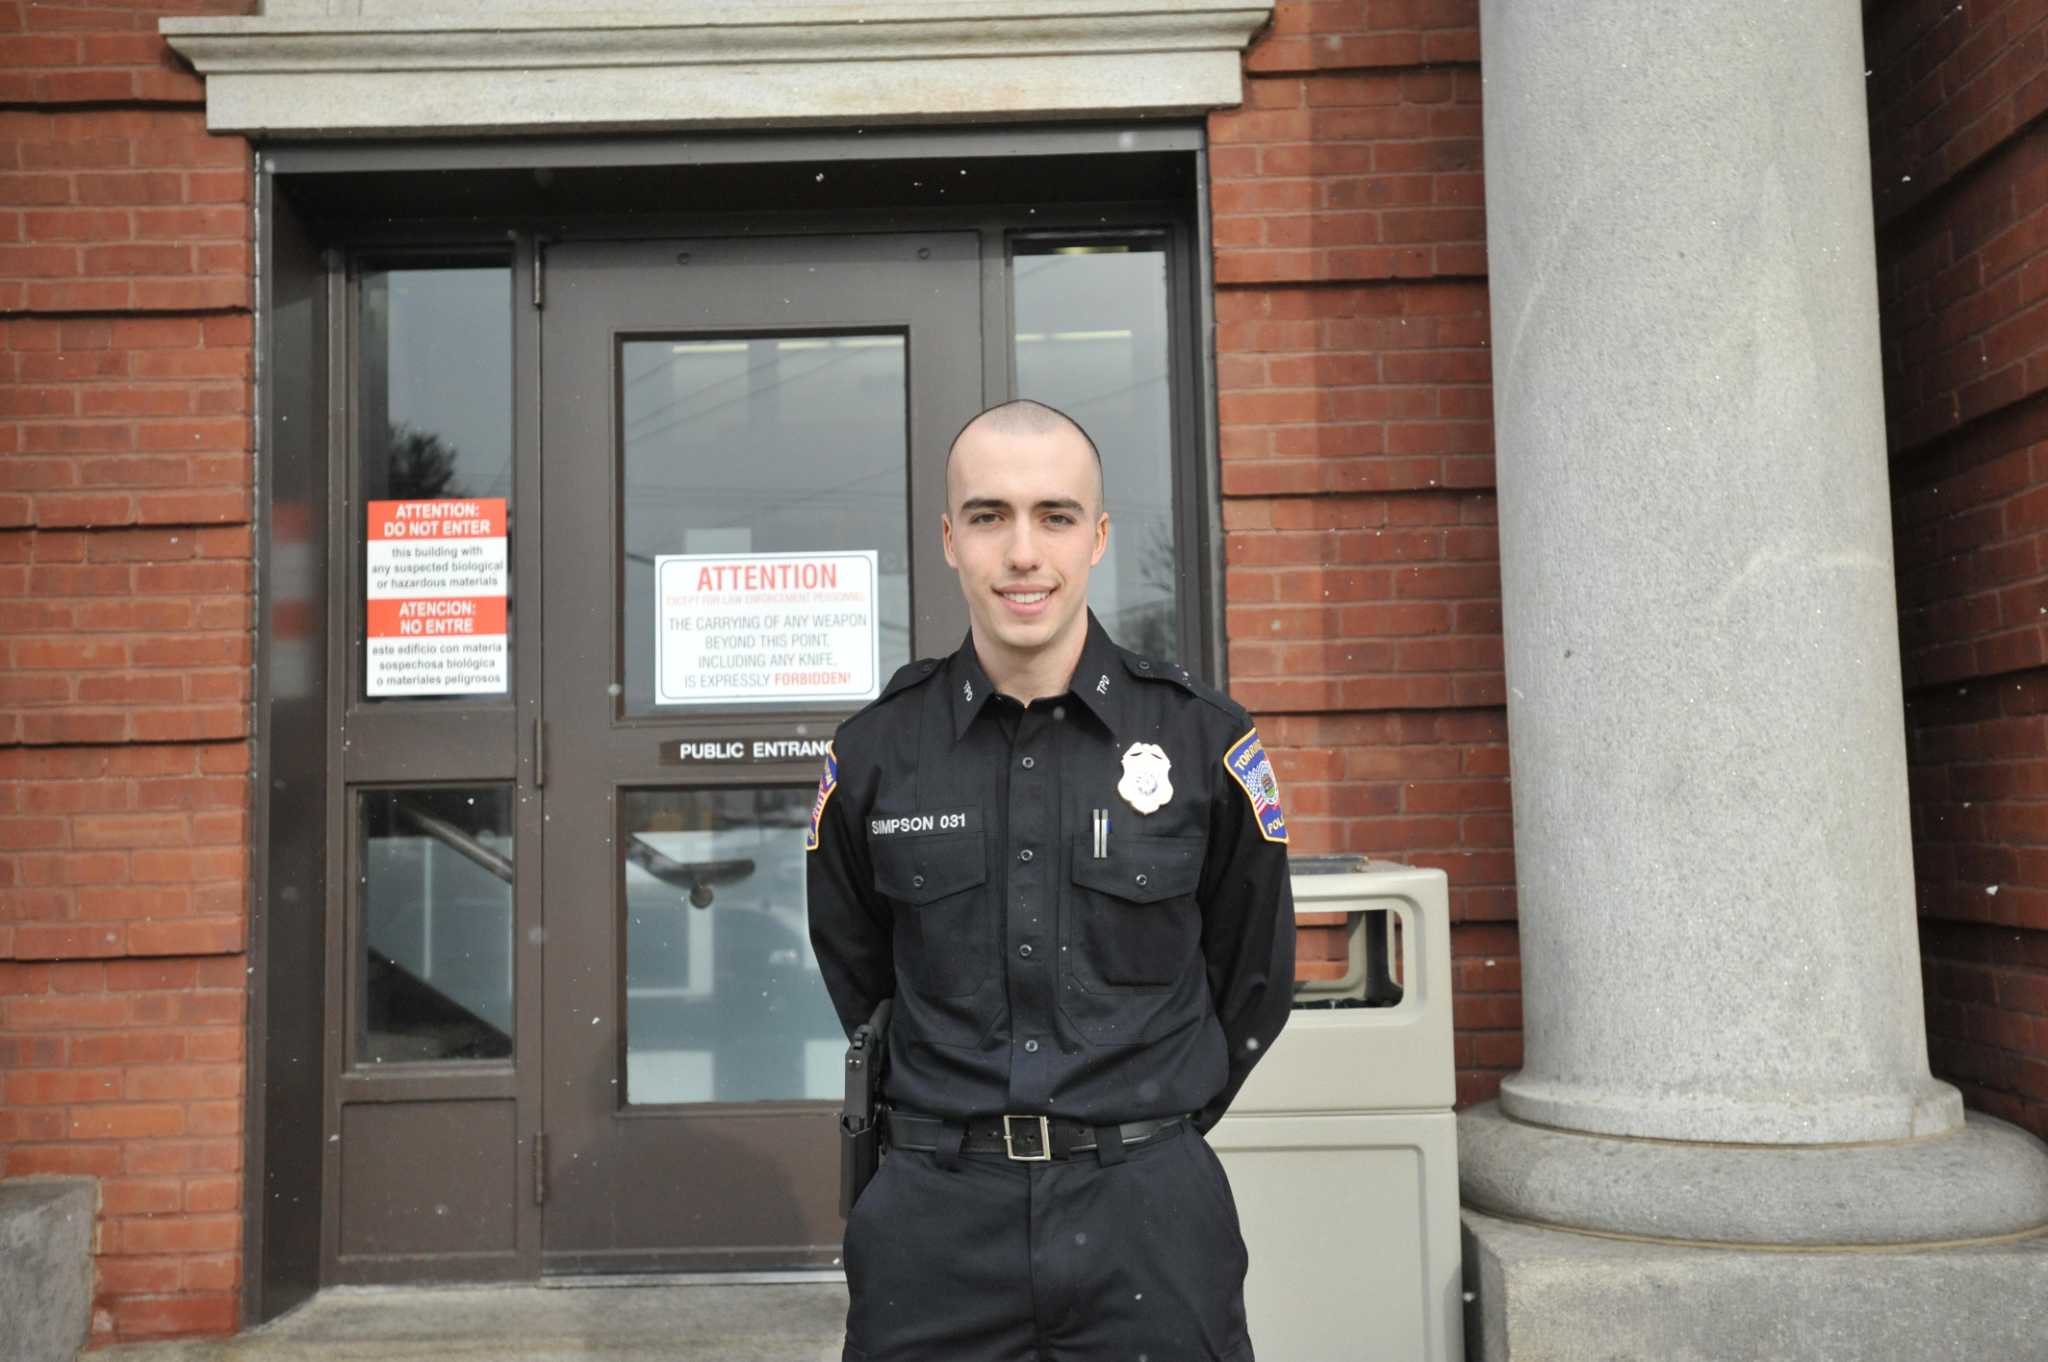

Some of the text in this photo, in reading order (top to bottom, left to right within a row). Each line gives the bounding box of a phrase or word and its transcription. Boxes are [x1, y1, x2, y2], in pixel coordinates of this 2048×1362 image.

[396, 502, 480, 519] ATTENTION:
[384, 519, 490, 537] DO NOT ENTER
[392, 546, 483, 559] this building with
[371, 561, 503, 575] any suspected biological
[377, 576, 498, 589] or hazardous materials
[697, 563, 837, 591] ATTENTION
[399, 601, 476, 617] ATENCION:
[400, 618, 473, 634] NO ENTRE
[669, 613, 867, 631] THE CARRYING OF ANY WEAPON
[398, 644, 437, 654] edificio
[440, 644, 459, 654] con
[463, 643, 502, 653] materia
[705, 635, 755, 650] BEYOND
[760, 634, 787, 649] THIS
[379, 657, 495, 671] sospechosa biológica
[698, 654, 766, 669] INCLUDING
[770, 653, 796, 667] ANY
[377, 673, 500, 686] o materiales peligrosos
[685, 672, 851, 688] IS EXPRESSLY FORBIDDEN!
[1096, 674, 1110, 695] TPD
[680, 742, 744, 759] PUBLIC
[871, 813, 966, 835] SIMPSON 031
